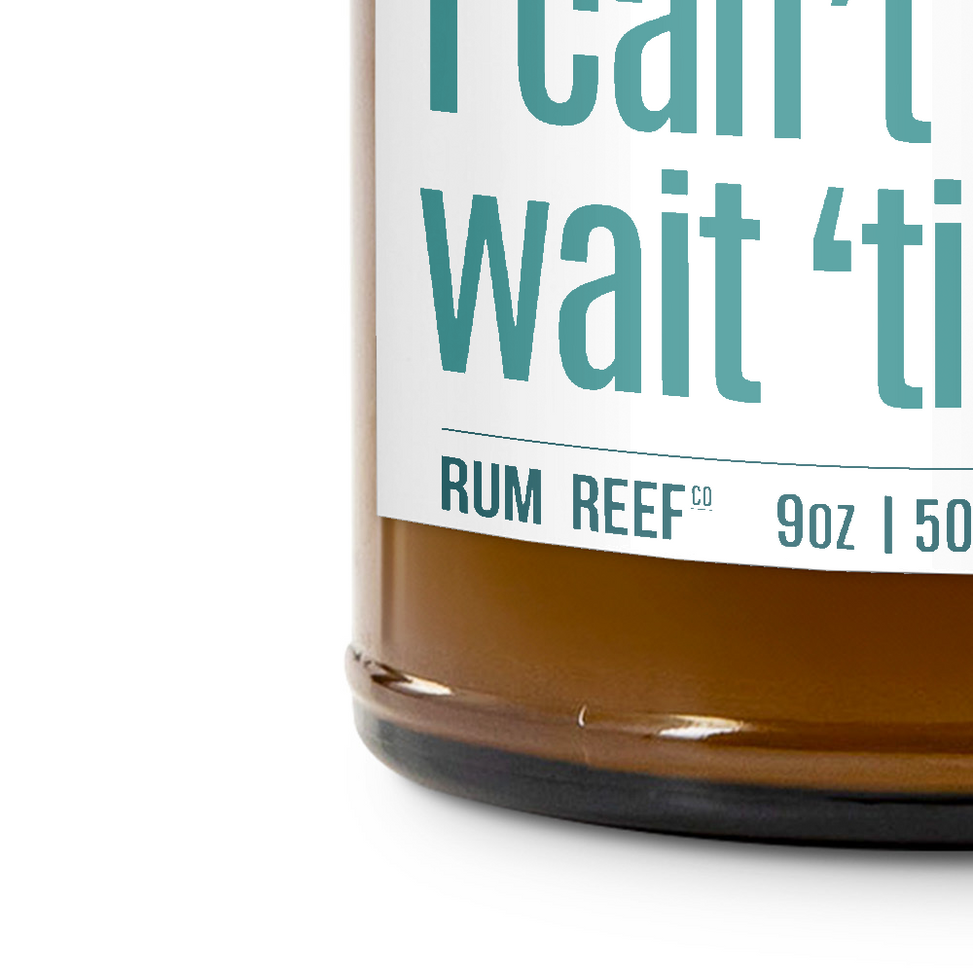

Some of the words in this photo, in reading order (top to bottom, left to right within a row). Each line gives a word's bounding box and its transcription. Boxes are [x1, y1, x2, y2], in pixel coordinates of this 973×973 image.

[420, 169, 761, 403] wait
[441, 456, 542, 525] RUM
[573, 474, 685, 539] REEF
[917, 499, 971, 552] 50
